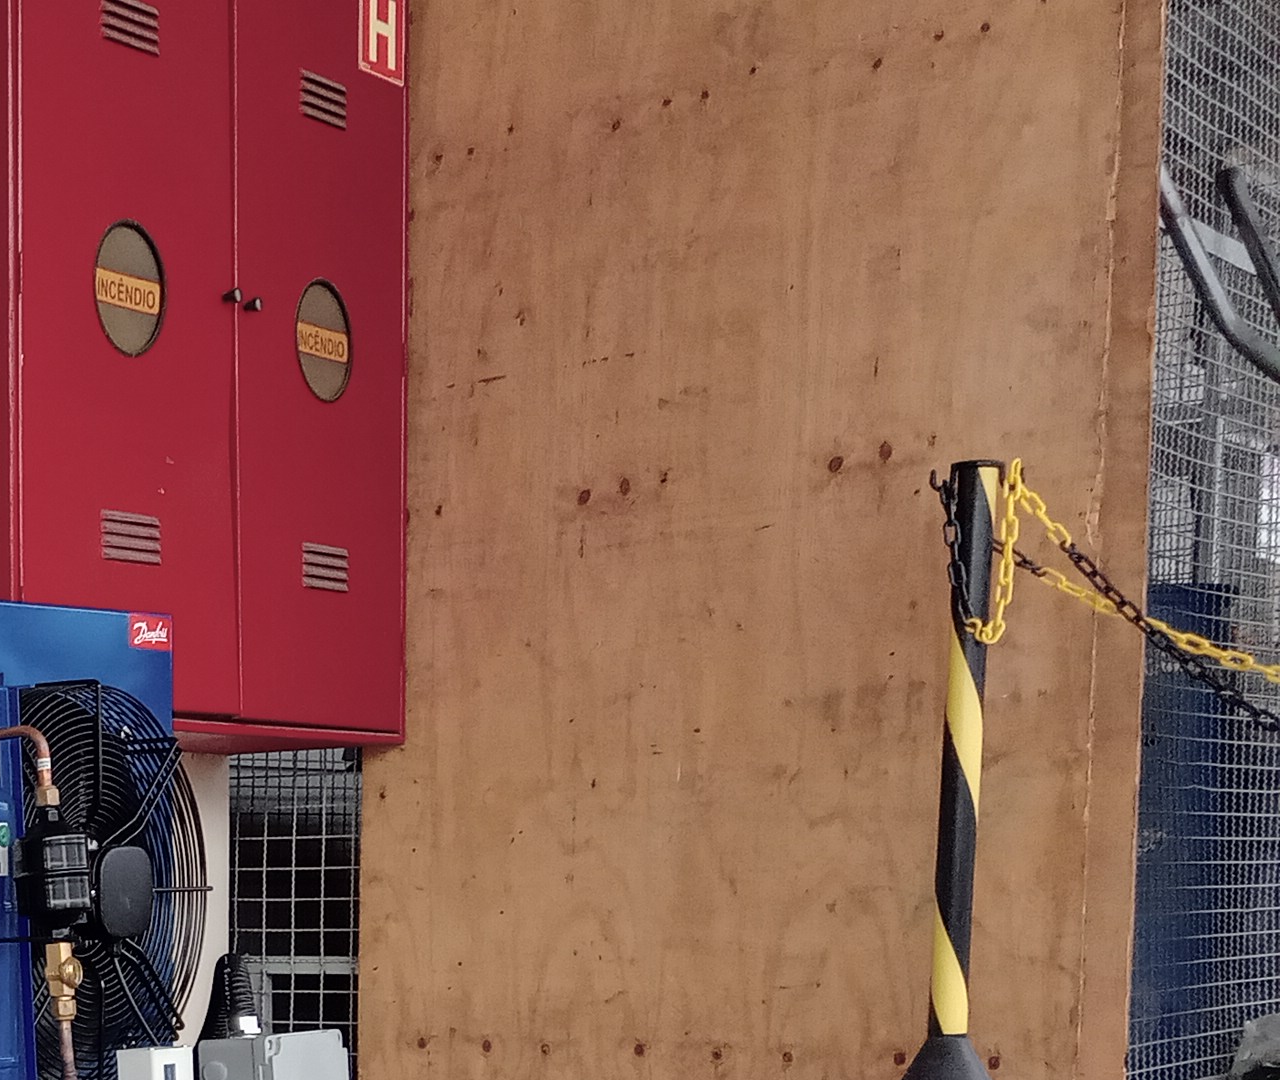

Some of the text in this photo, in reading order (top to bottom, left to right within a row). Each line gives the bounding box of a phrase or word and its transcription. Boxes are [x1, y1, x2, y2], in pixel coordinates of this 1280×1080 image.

[97, 277, 156, 309] INCÊNDIO
[298, 330, 345, 358] INCÊNDIO
[133, 621, 168, 645] Danfoss
